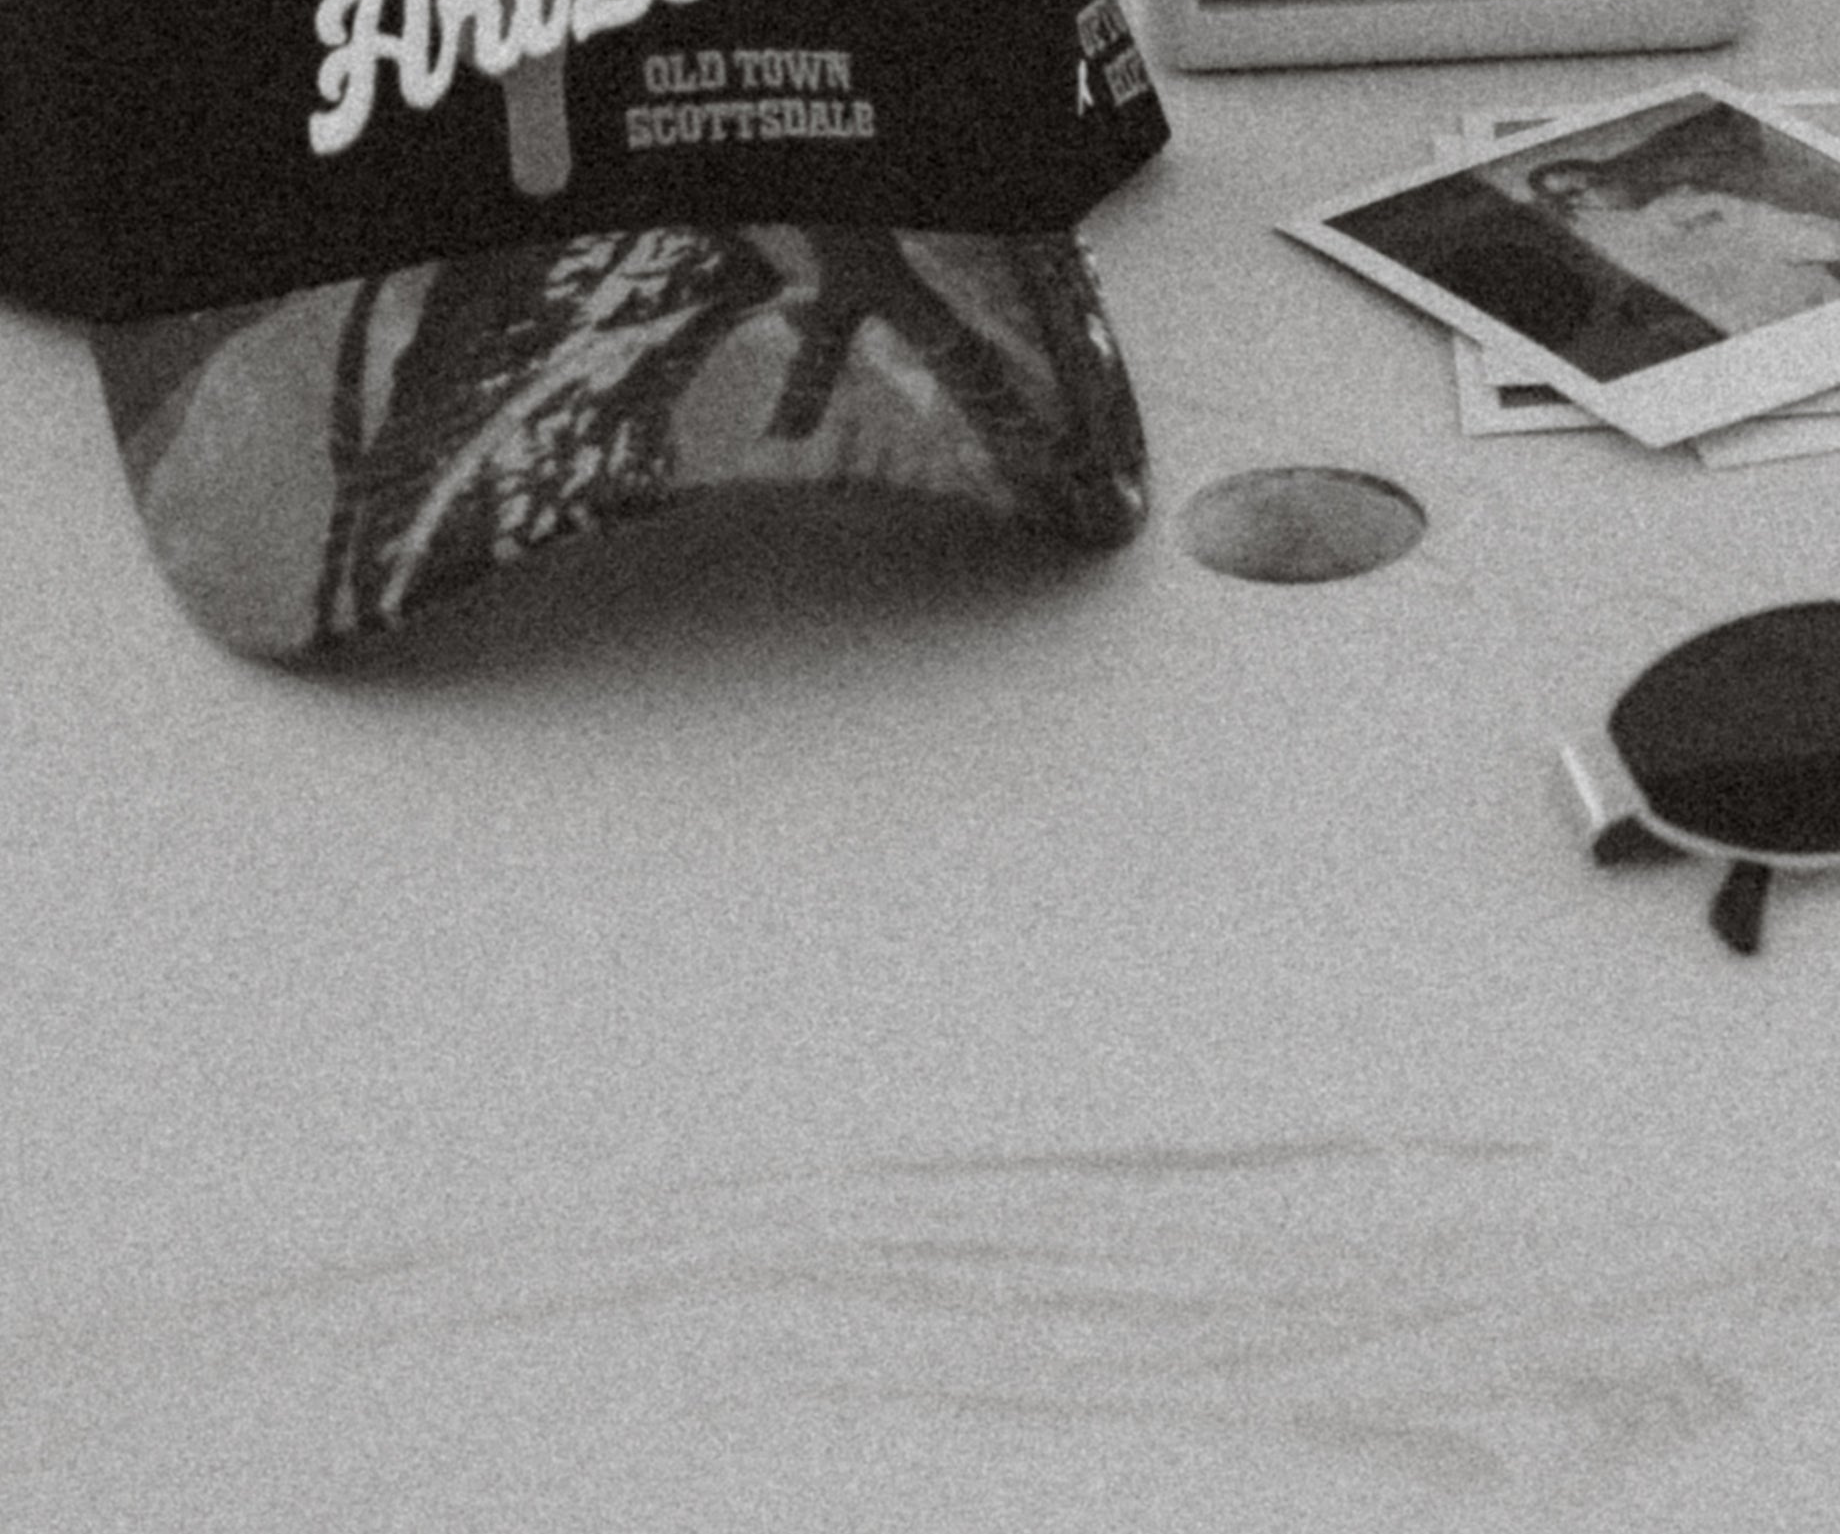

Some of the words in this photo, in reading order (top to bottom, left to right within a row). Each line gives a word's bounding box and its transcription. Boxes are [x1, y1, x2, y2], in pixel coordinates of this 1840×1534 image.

[643, 49, 727, 94] OLD
[732, 47, 852, 92] TOWN
[625, 97, 875, 150] SCOTTSDALE
